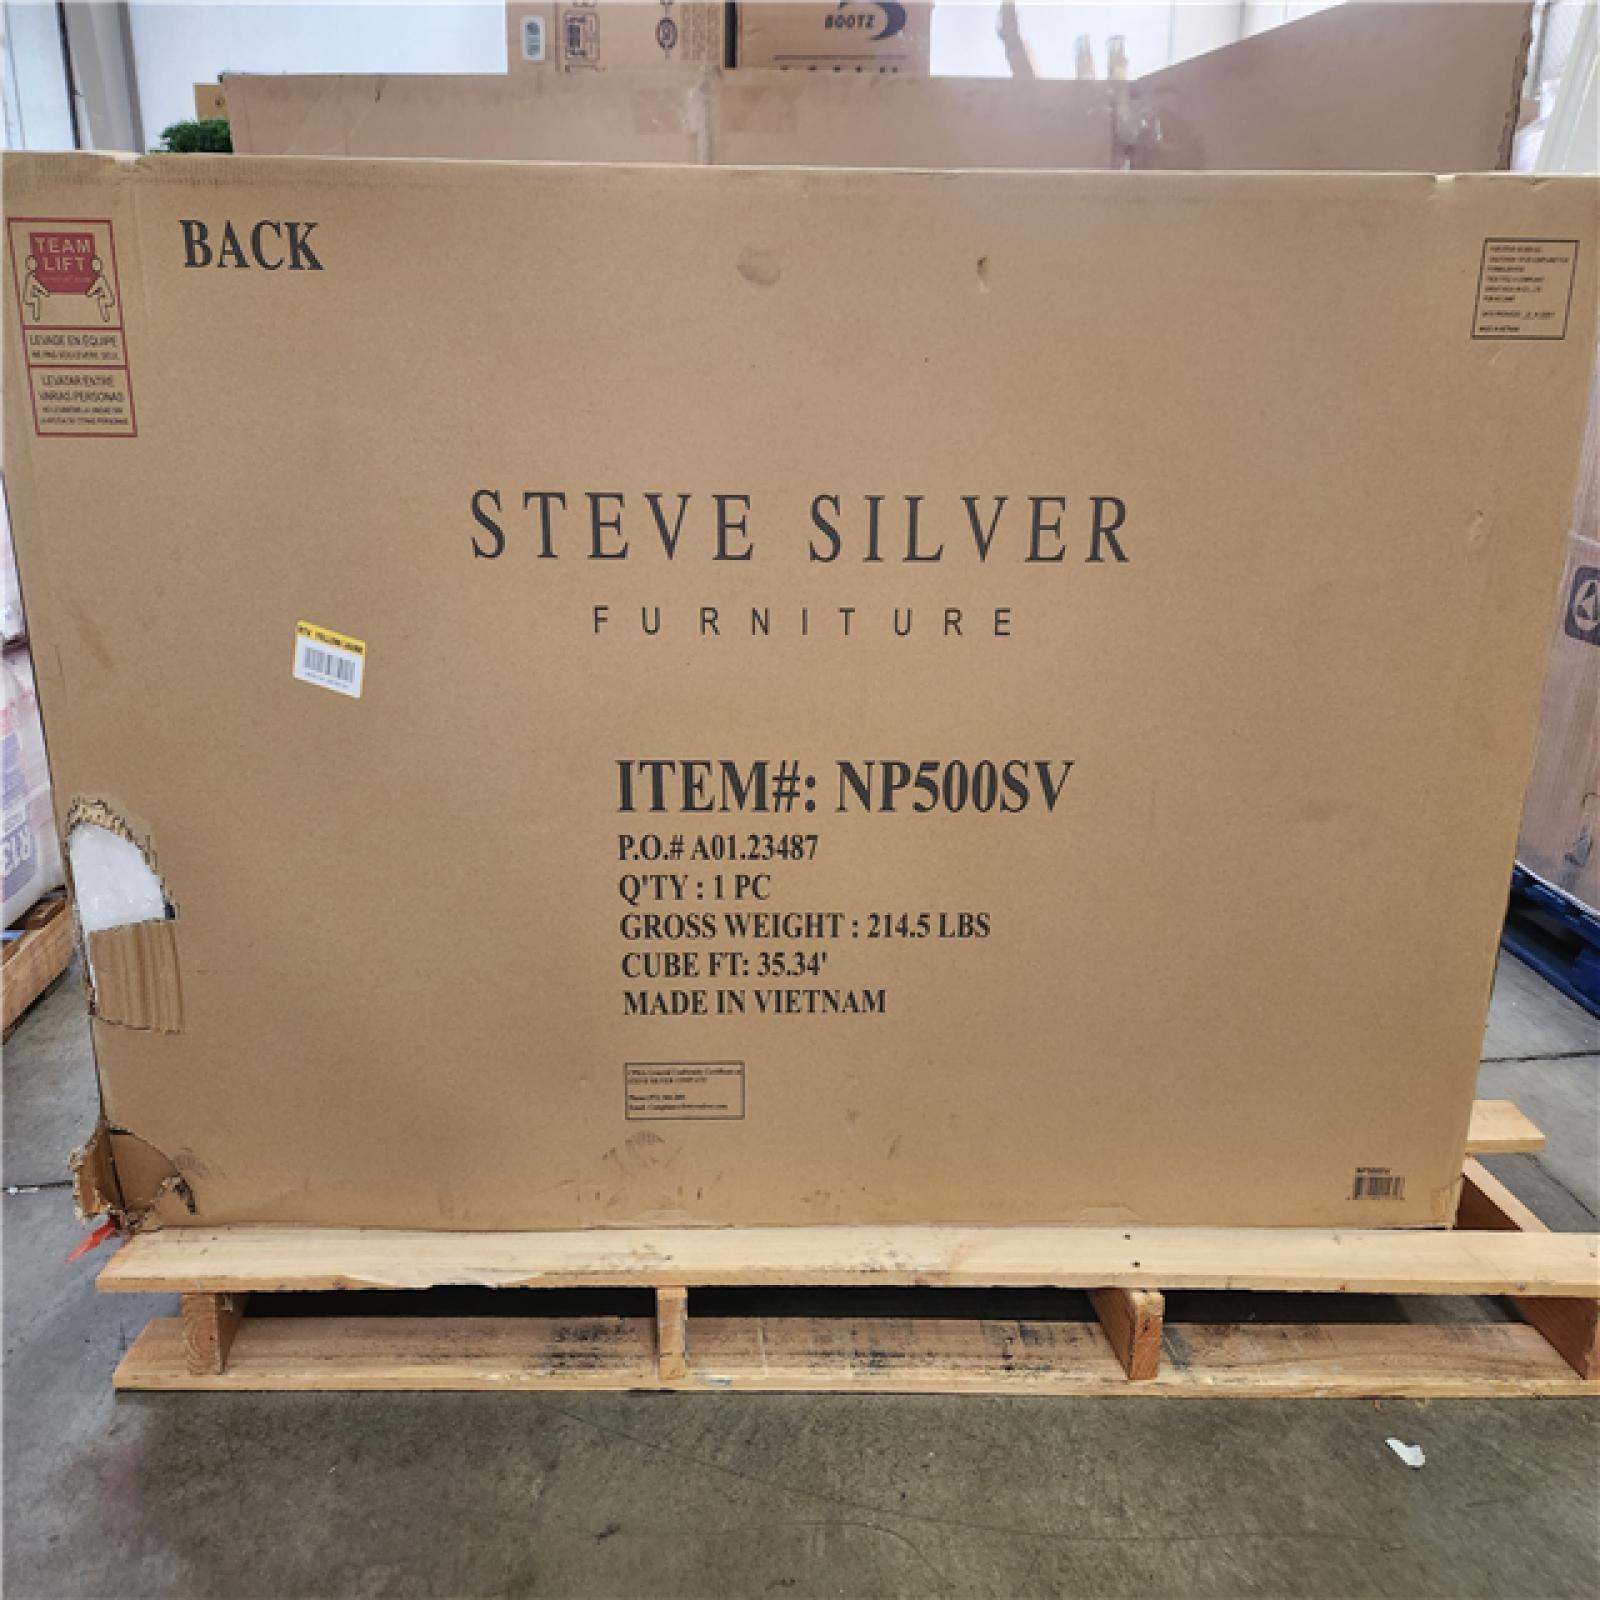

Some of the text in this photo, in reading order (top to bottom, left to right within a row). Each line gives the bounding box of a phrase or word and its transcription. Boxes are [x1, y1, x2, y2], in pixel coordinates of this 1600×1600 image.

[824, 14, 875, 29] BOOTZ
[34, 237, 91, 253] TEAM
[178, 219, 324, 271] BACK
[43, 257, 84, 271] LIFT
[470, 488, 1131, 563] STEVE SILVER
[594, 605, 1013, 636] FURNITURE
[615, 759, 1076, 814] ITEM#: NP500SV
[618, 834, 819, 861] P.O.# A01.23487
[619, 873, 771, 907] Q'TY : 1 PC
[619, 912, 991, 940] GROSS WEIGHT : 214.5 LBS
[621, 951, 828, 978] CUBE FT: 35.34'
[623, 989, 887, 1016] MADE IN VIETNAM
